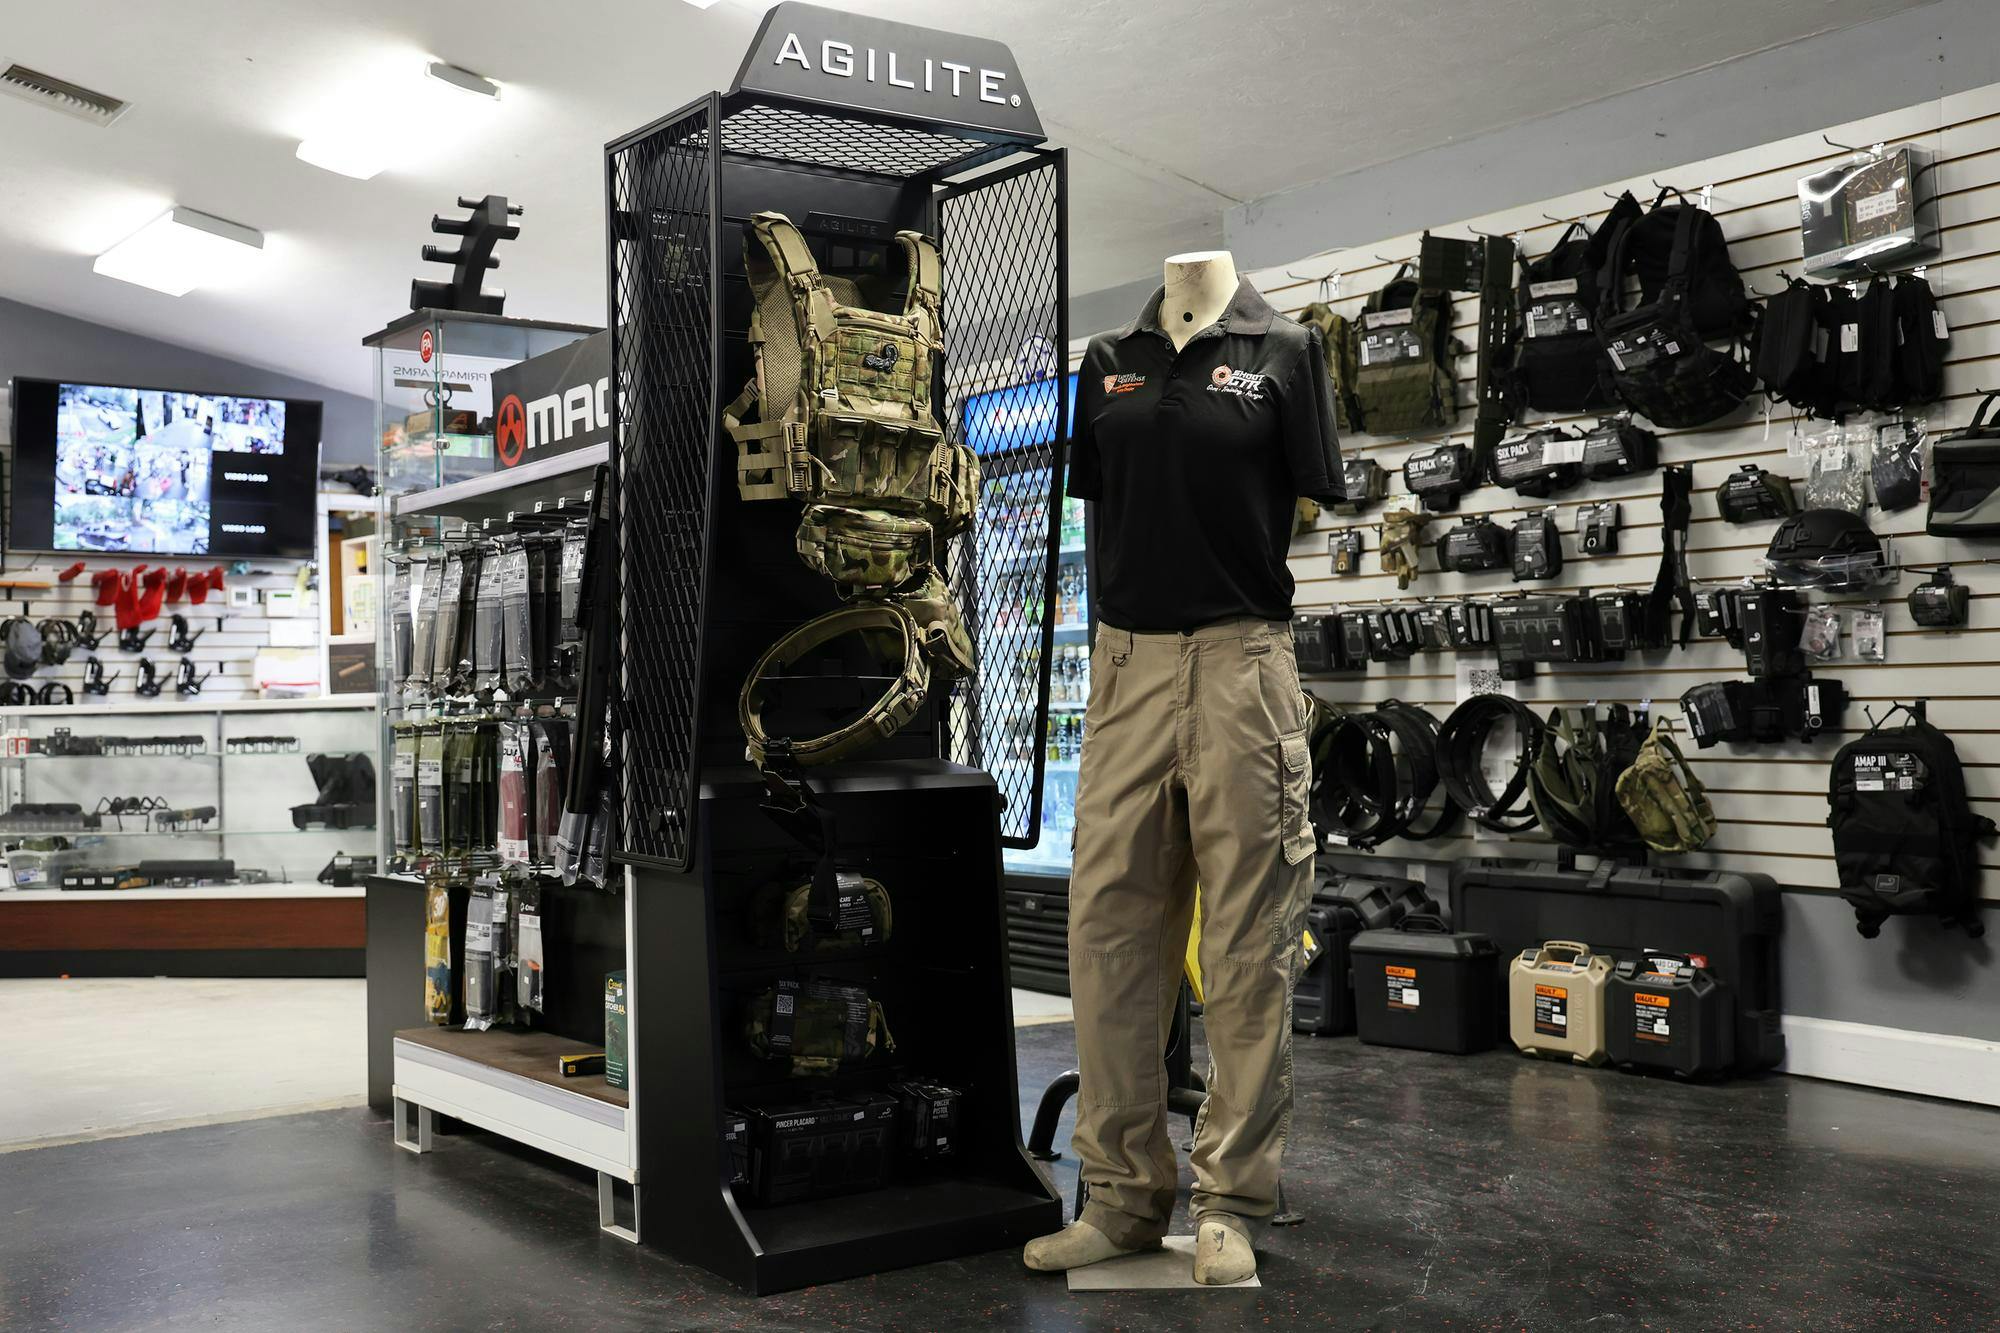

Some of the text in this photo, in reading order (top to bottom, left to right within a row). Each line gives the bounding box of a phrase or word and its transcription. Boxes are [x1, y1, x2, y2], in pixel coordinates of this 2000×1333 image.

[818, 217, 880, 237] AGILITE
[1231, 369, 1266, 381] SHOOT
[1227, 376, 1263, 392] GTR
[1497, 443, 1530, 460] SIX PACK
[1408, 459, 1437, 473] SIX PACK
[1854, 755, 1877, 767] AMAP
[1877, 755, 1887, 766] III
[1636, 995, 1659, 1003] VAULT
[775, 1119, 794, 1129] PINCER
